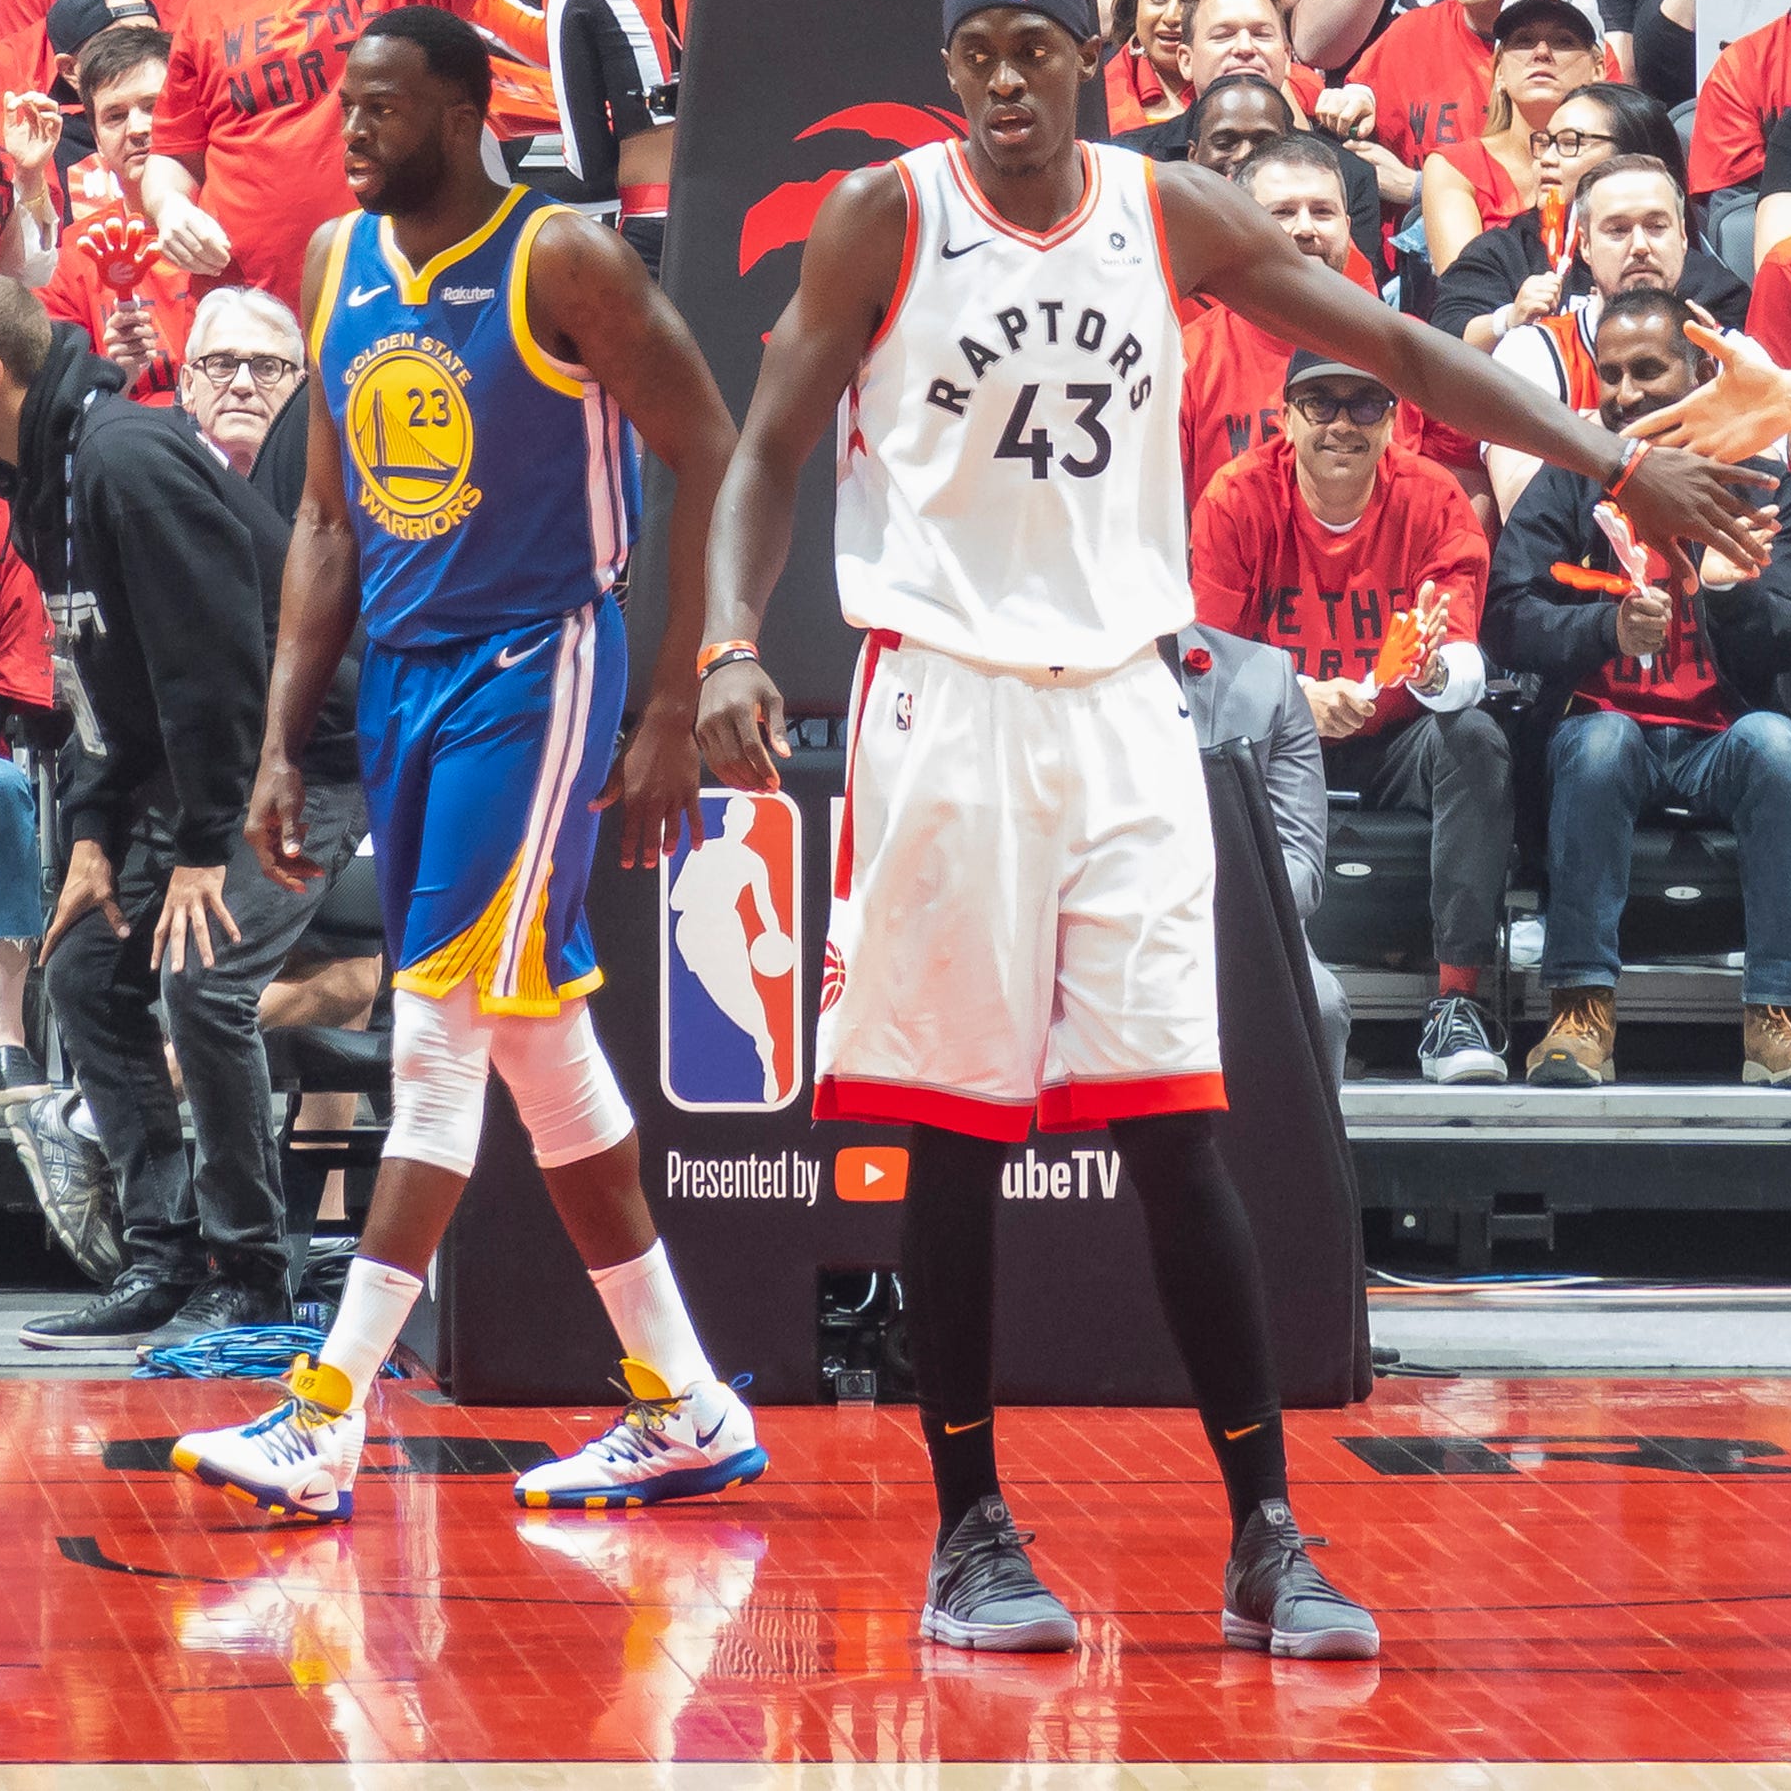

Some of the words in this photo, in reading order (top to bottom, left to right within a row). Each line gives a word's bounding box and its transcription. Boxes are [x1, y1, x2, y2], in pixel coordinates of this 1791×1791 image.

[222, 17, 278, 63] WE
[228, 47, 355, 115] NORT
[1409, 102, 1459, 146] WE
[442, 286, 496, 305] Rakuten
[343, 332, 418, 387] GOLDEN
[420, 332, 474, 387] STATE
[926, 299, 1154, 417] RAPTORS
[407, 387, 452, 429] 23
[994, 383, 1112, 480] 43
[1225, 408, 1280, 457] WE
[358, 481, 485, 541] WARRIORS
[1318, 587, 1408, 641] THE
[666, 1147, 778, 1201] Presented
[786, 1147, 820, 1206] by
[1001, 1148, 1121, 1201] ubeTV
